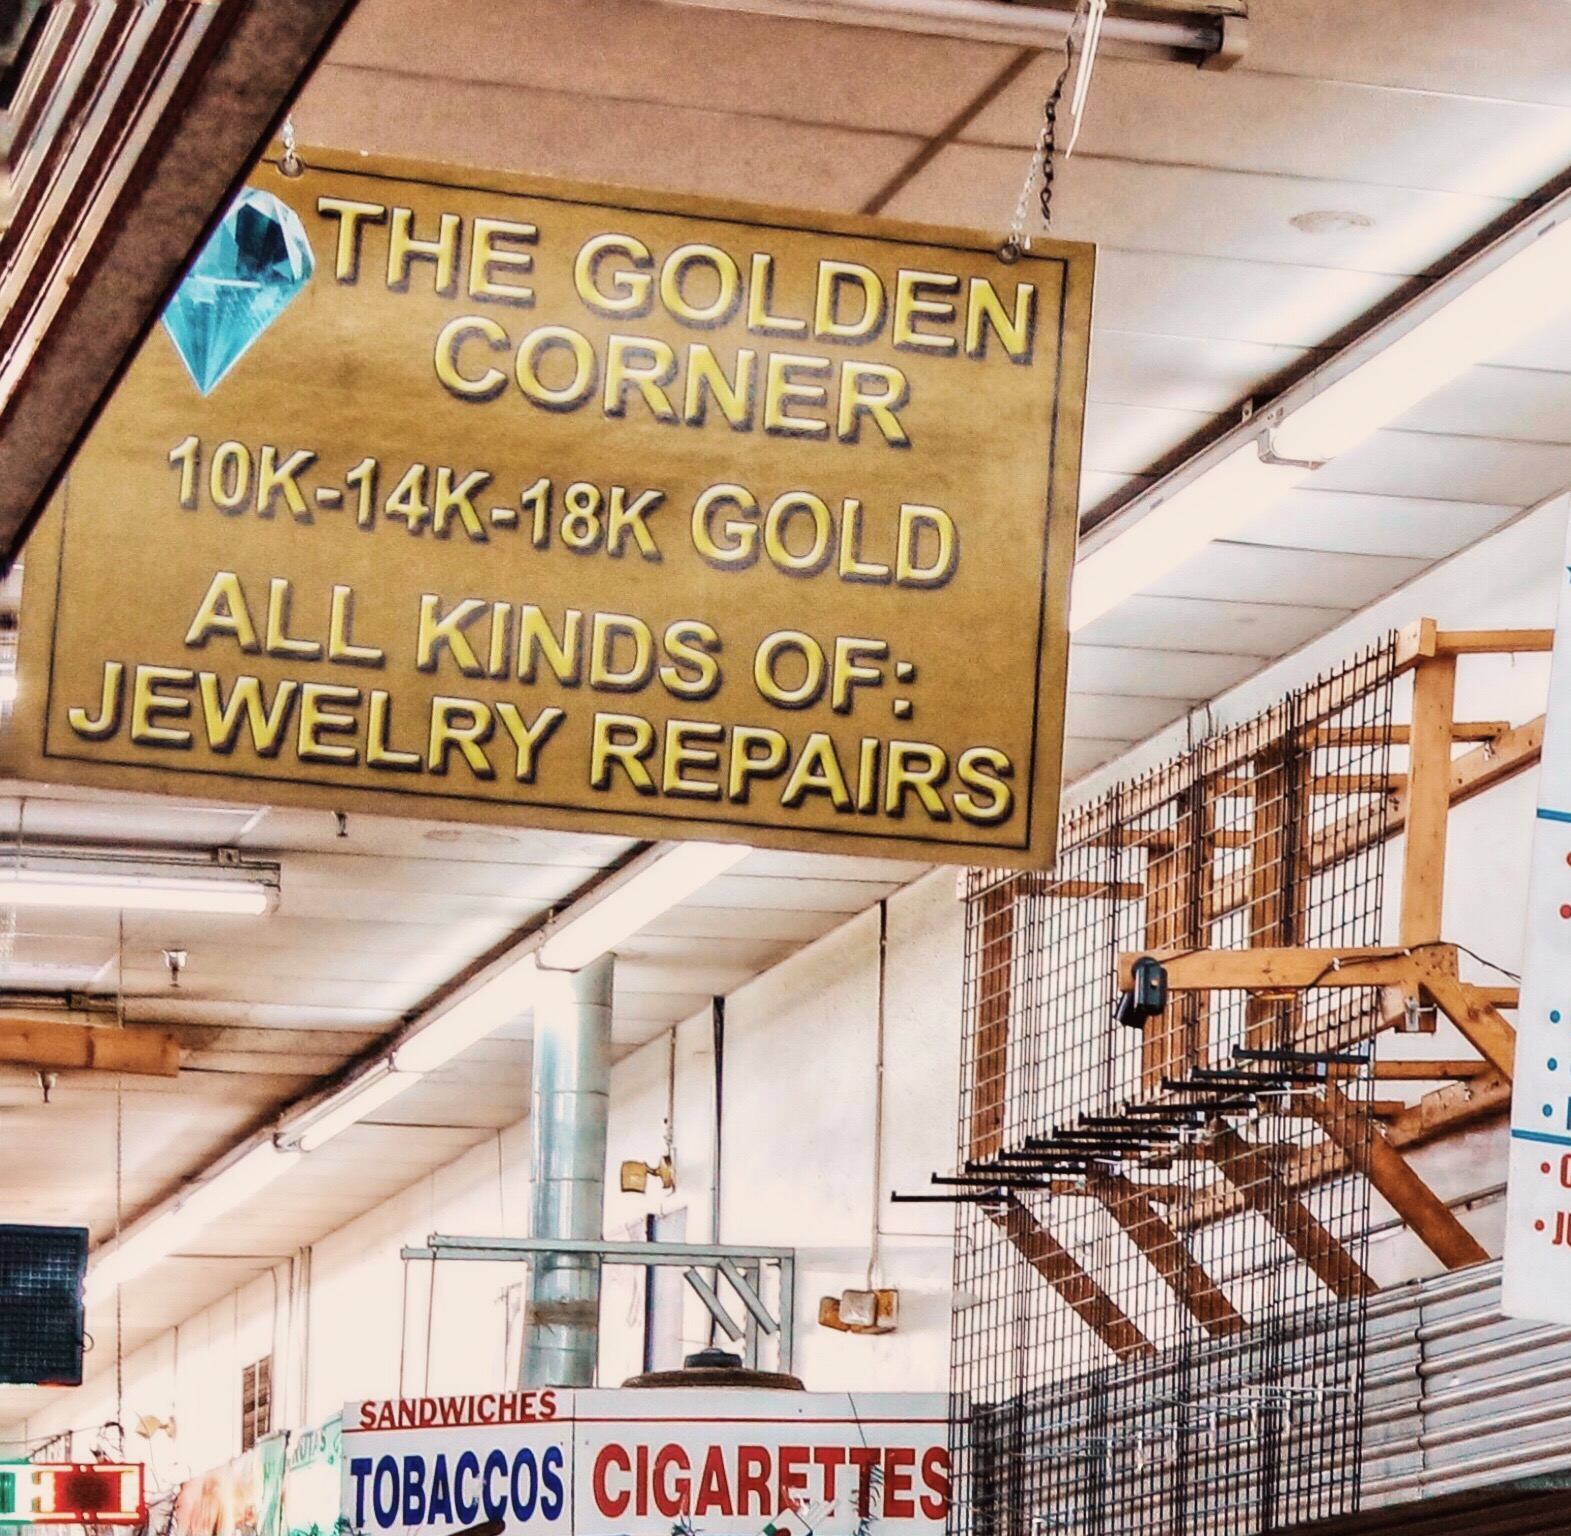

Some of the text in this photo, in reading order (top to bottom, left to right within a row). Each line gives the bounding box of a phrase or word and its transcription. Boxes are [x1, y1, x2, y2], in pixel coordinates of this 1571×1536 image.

[318, 196, 1035, 362] THE GOLDEN
[434, 316, 910, 447] CORNER
[170, 436, 960, 587] 10K-14K-18K GOLD
[186, 572, 916, 717] ALL KINDS OF:
[70, 661, 1015, 823] JEWELRY REPAIRS
[359, 1390, 556, 1430] SANDWICHES
[351, 1443, 952, 1529] TOBACCOS CIGARETTES
